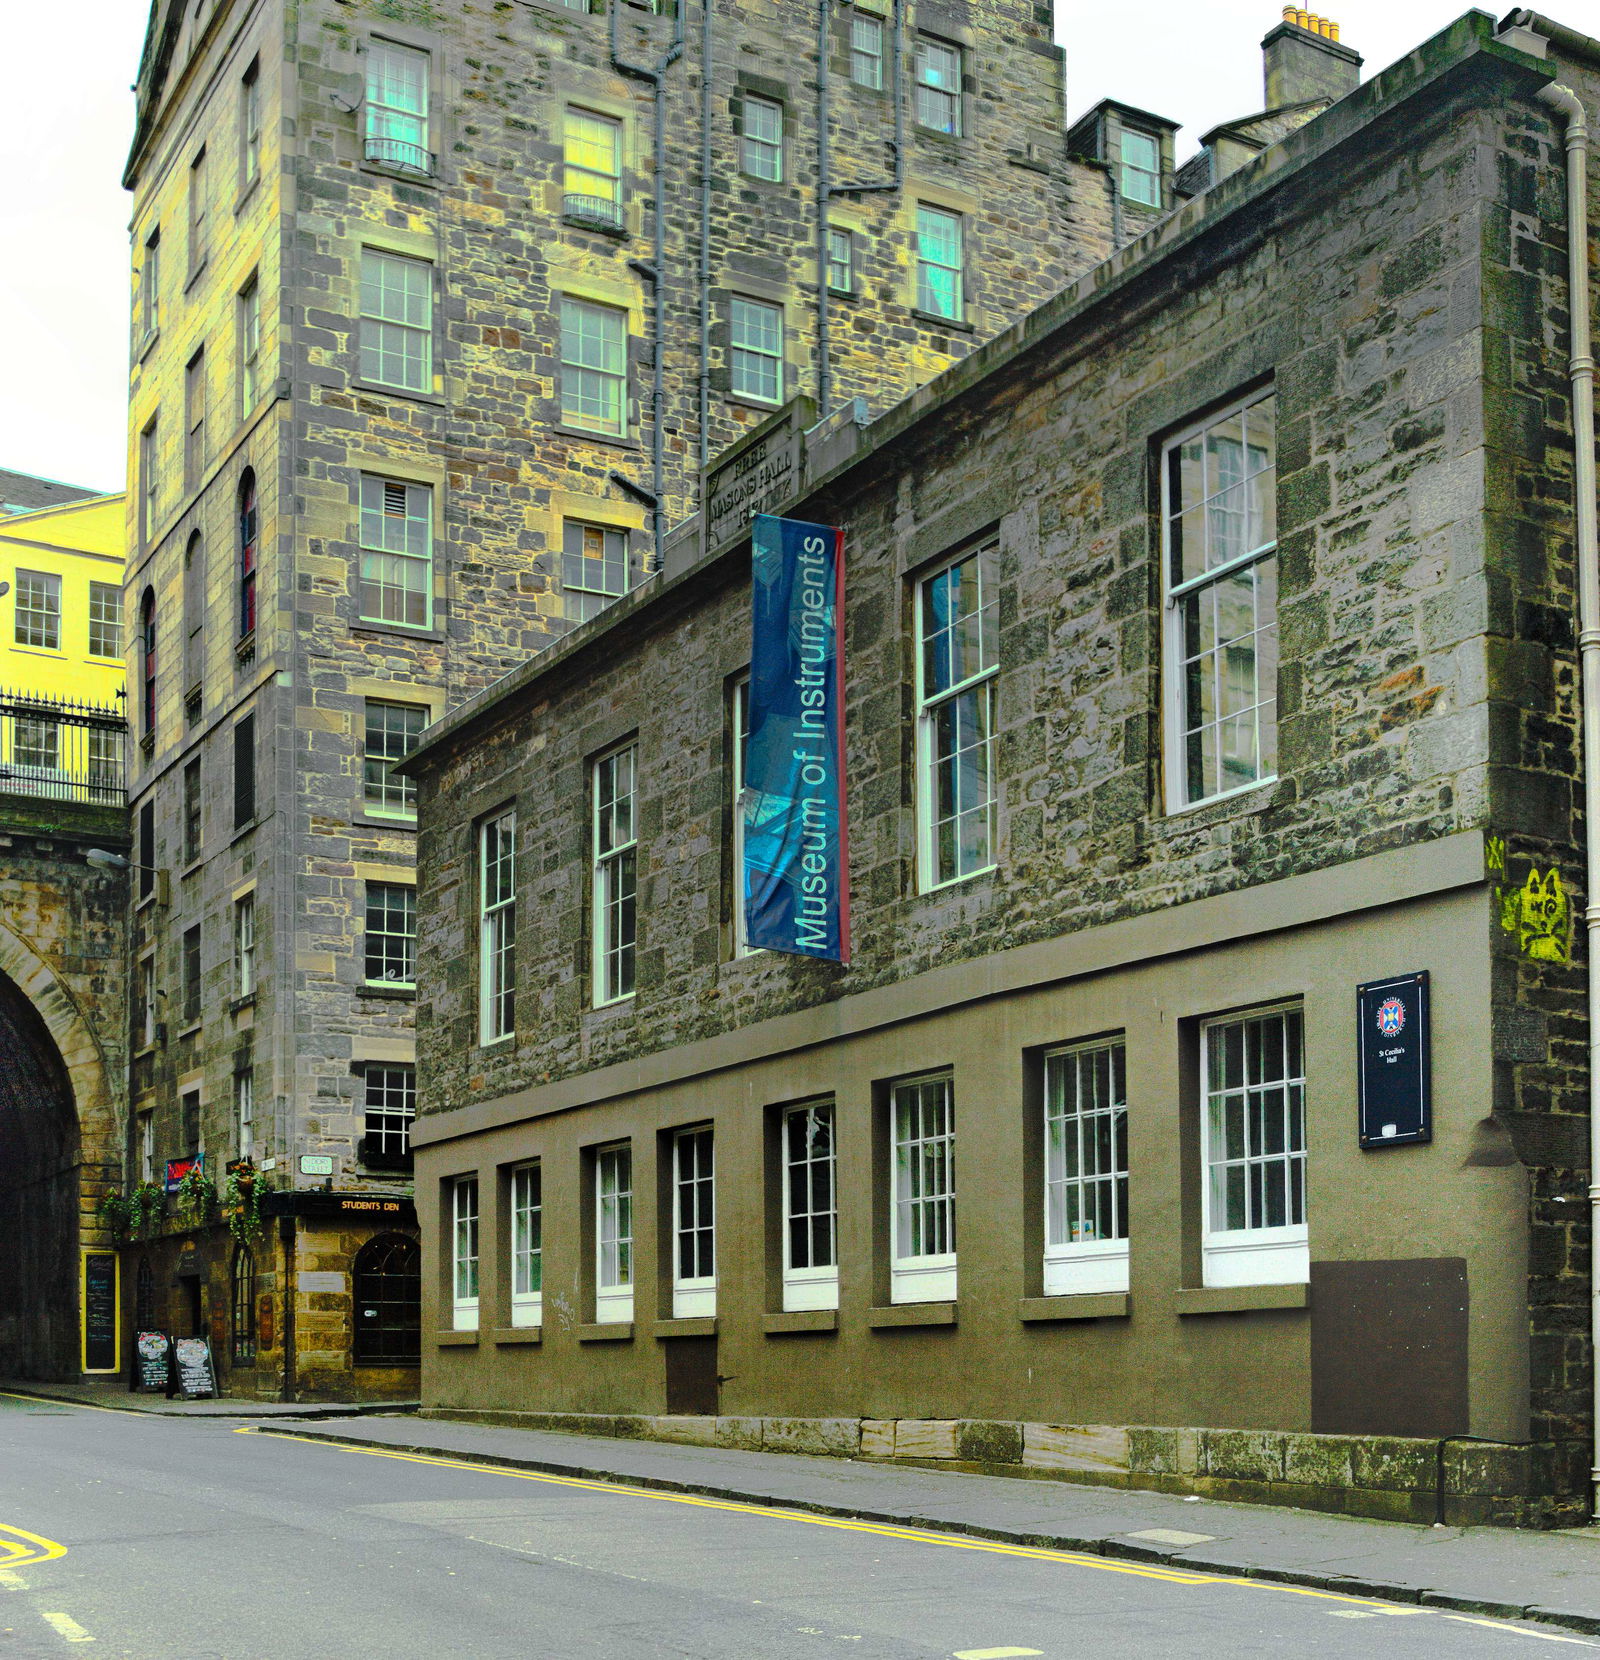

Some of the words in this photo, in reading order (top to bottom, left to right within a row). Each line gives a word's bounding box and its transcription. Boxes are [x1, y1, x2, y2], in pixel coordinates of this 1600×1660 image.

[734, 442, 766, 481] FREE
[759, 451, 792, 489] HALL
[792, 536, 826, 739] Instruments
[792, 749, 826, 786] of
[794, 797, 828, 950] Museum
[341, 1201, 381, 1211] STUDENTS
[383, 1202, 400, 1211] DEN
